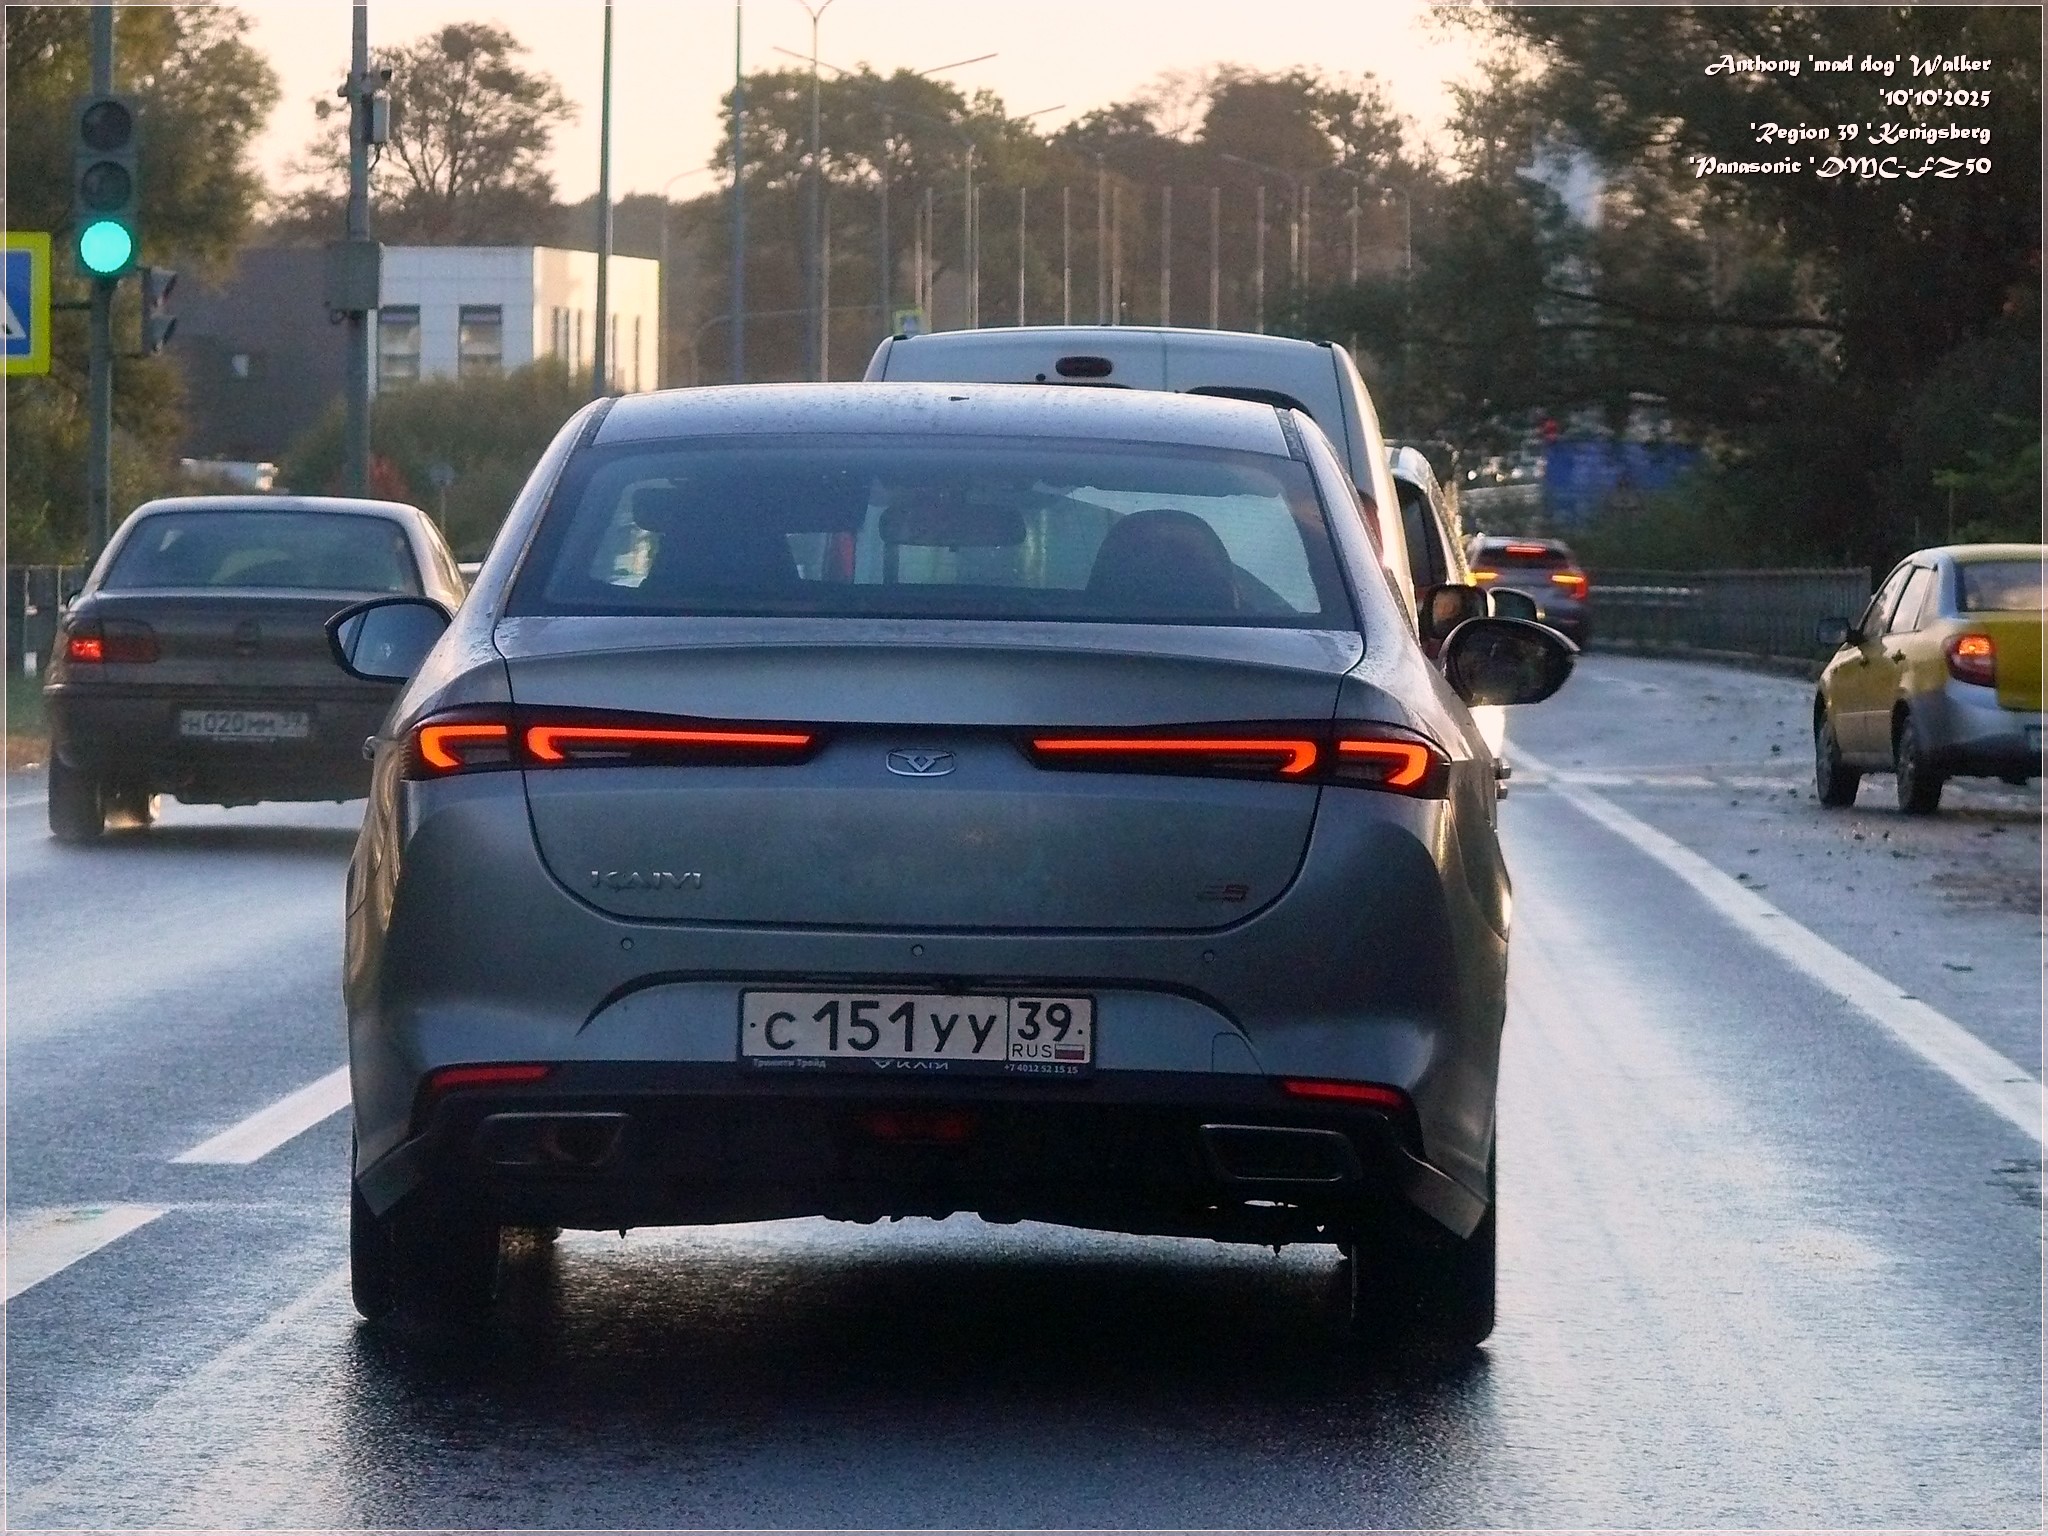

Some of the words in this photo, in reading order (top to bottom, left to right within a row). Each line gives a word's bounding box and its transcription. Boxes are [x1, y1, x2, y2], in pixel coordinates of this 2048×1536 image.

[1016, 1001, 1073, 1042] 39
[1012, 1043, 1053, 1058] RUS
[1004, 1064, 1016, 1072] +7
[1017, 1065, 1040, 1073] 4012
[1055, 1066, 1066, 1074] 15
[1067, 1066, 1079, 1074] 15
